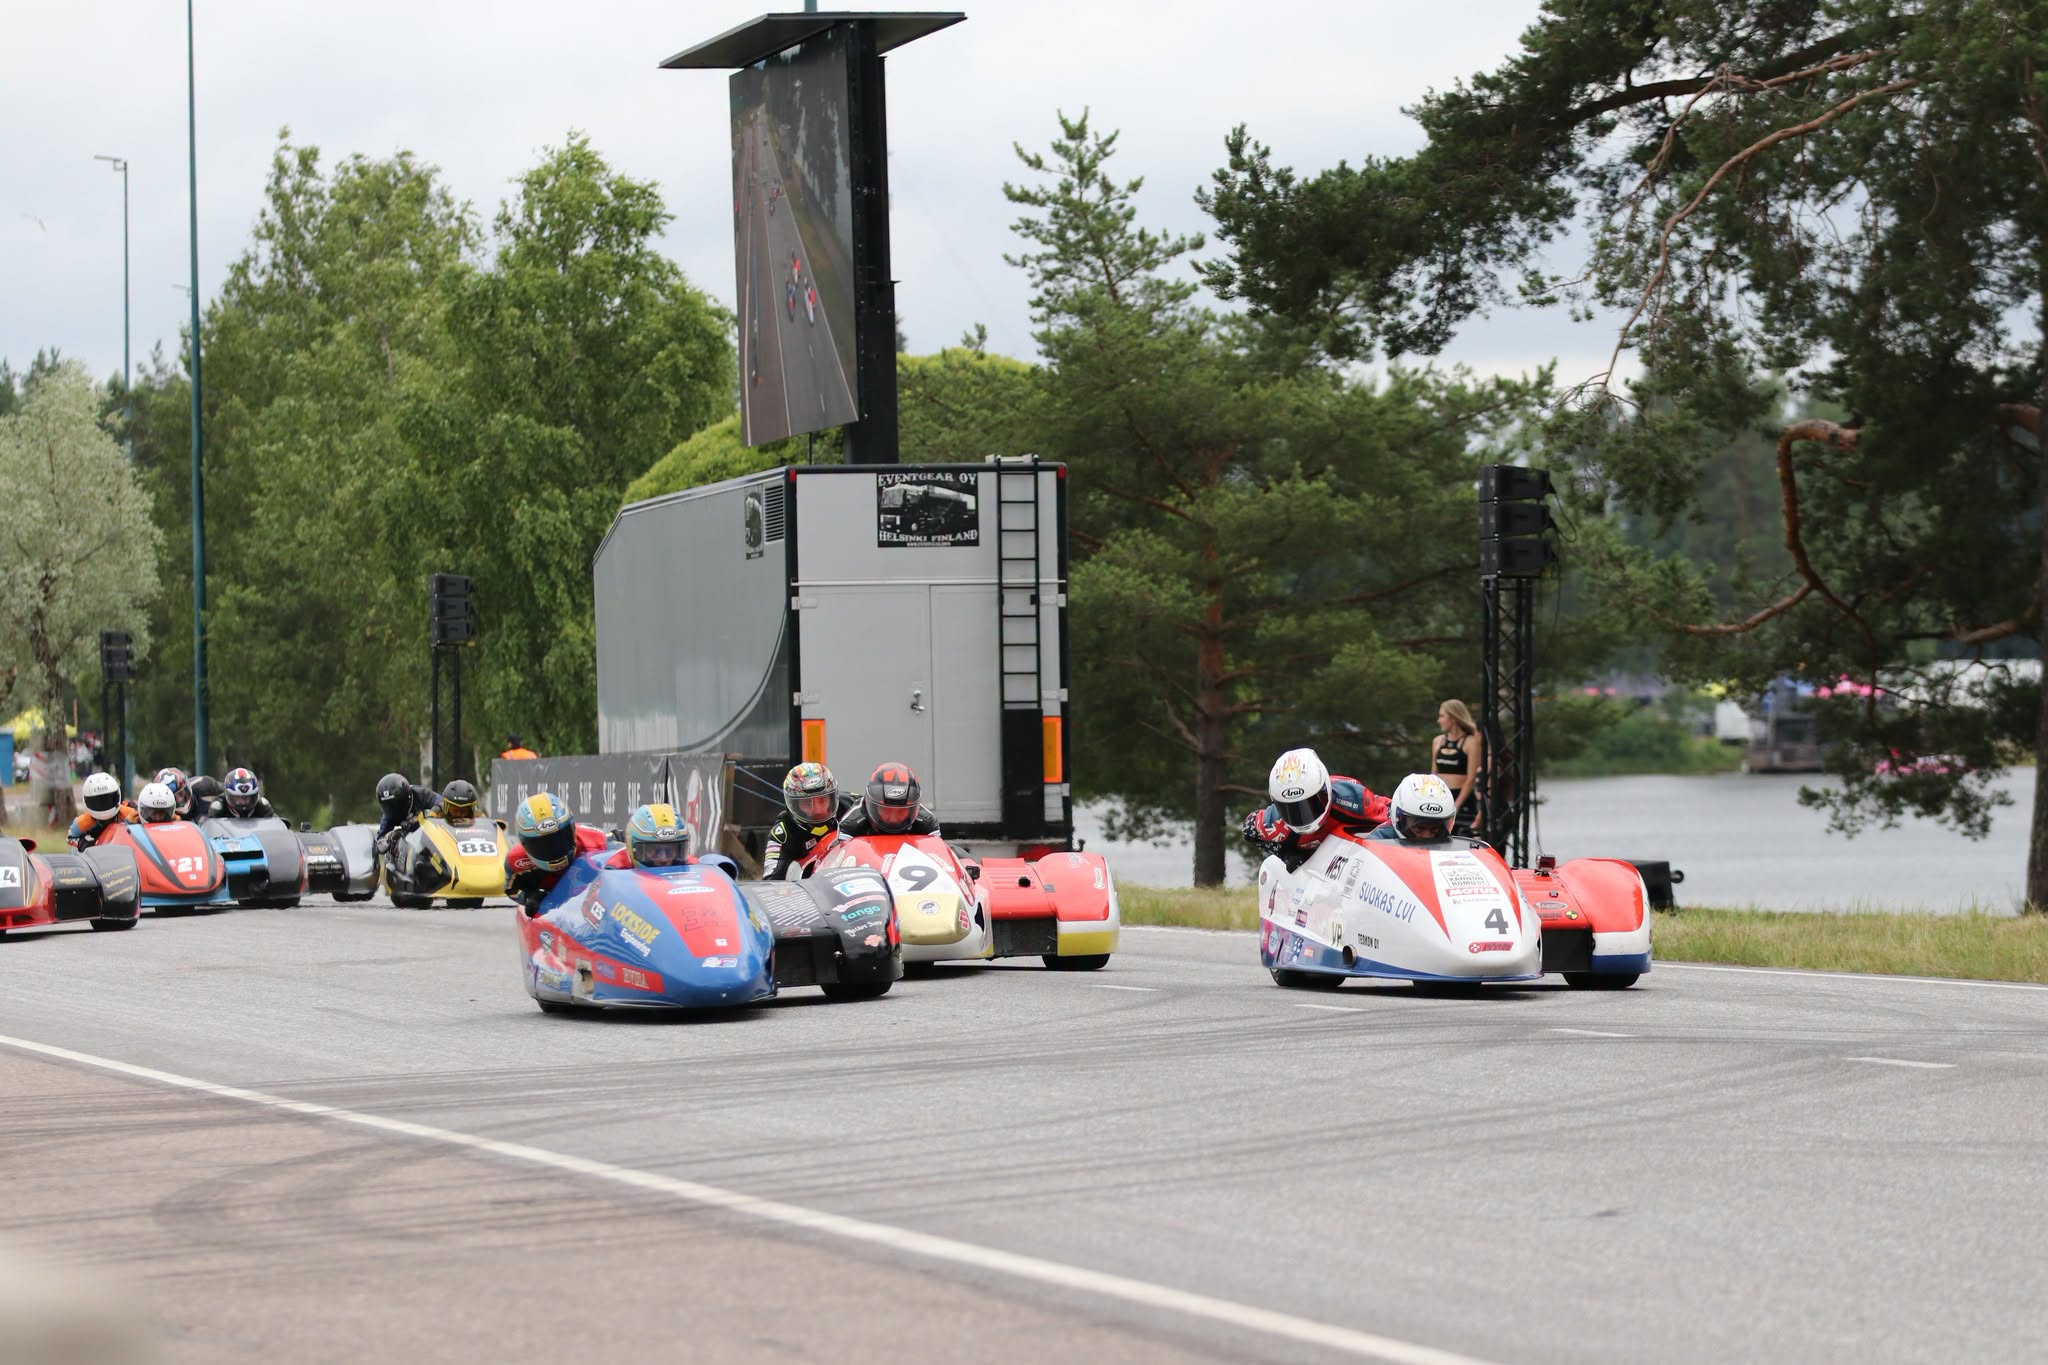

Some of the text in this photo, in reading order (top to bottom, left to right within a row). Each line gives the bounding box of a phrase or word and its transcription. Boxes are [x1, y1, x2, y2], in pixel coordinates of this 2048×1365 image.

[878, 473, 977, 487] EVENTGEAR OY
[879, 530, 978, 541] HELSINKI FINLAND
[1282, 788, 1304, 798] Arai
[1420, 803, 1442, 814] Arai
[538, 820, 558, 831] Arai
[656, 828, 677, 838] Arai
[461, 843, 496, 853] 88
[177, 856, 203, 873] 21
[1, 869, 17, 884] 4
[899, 865, 939, 891] 9
[1359, 881, 1395, 914] SUOKAS
[610, 901, 661, 945] LOCKSIDE
[1484, 908, 1509, 934] 4
